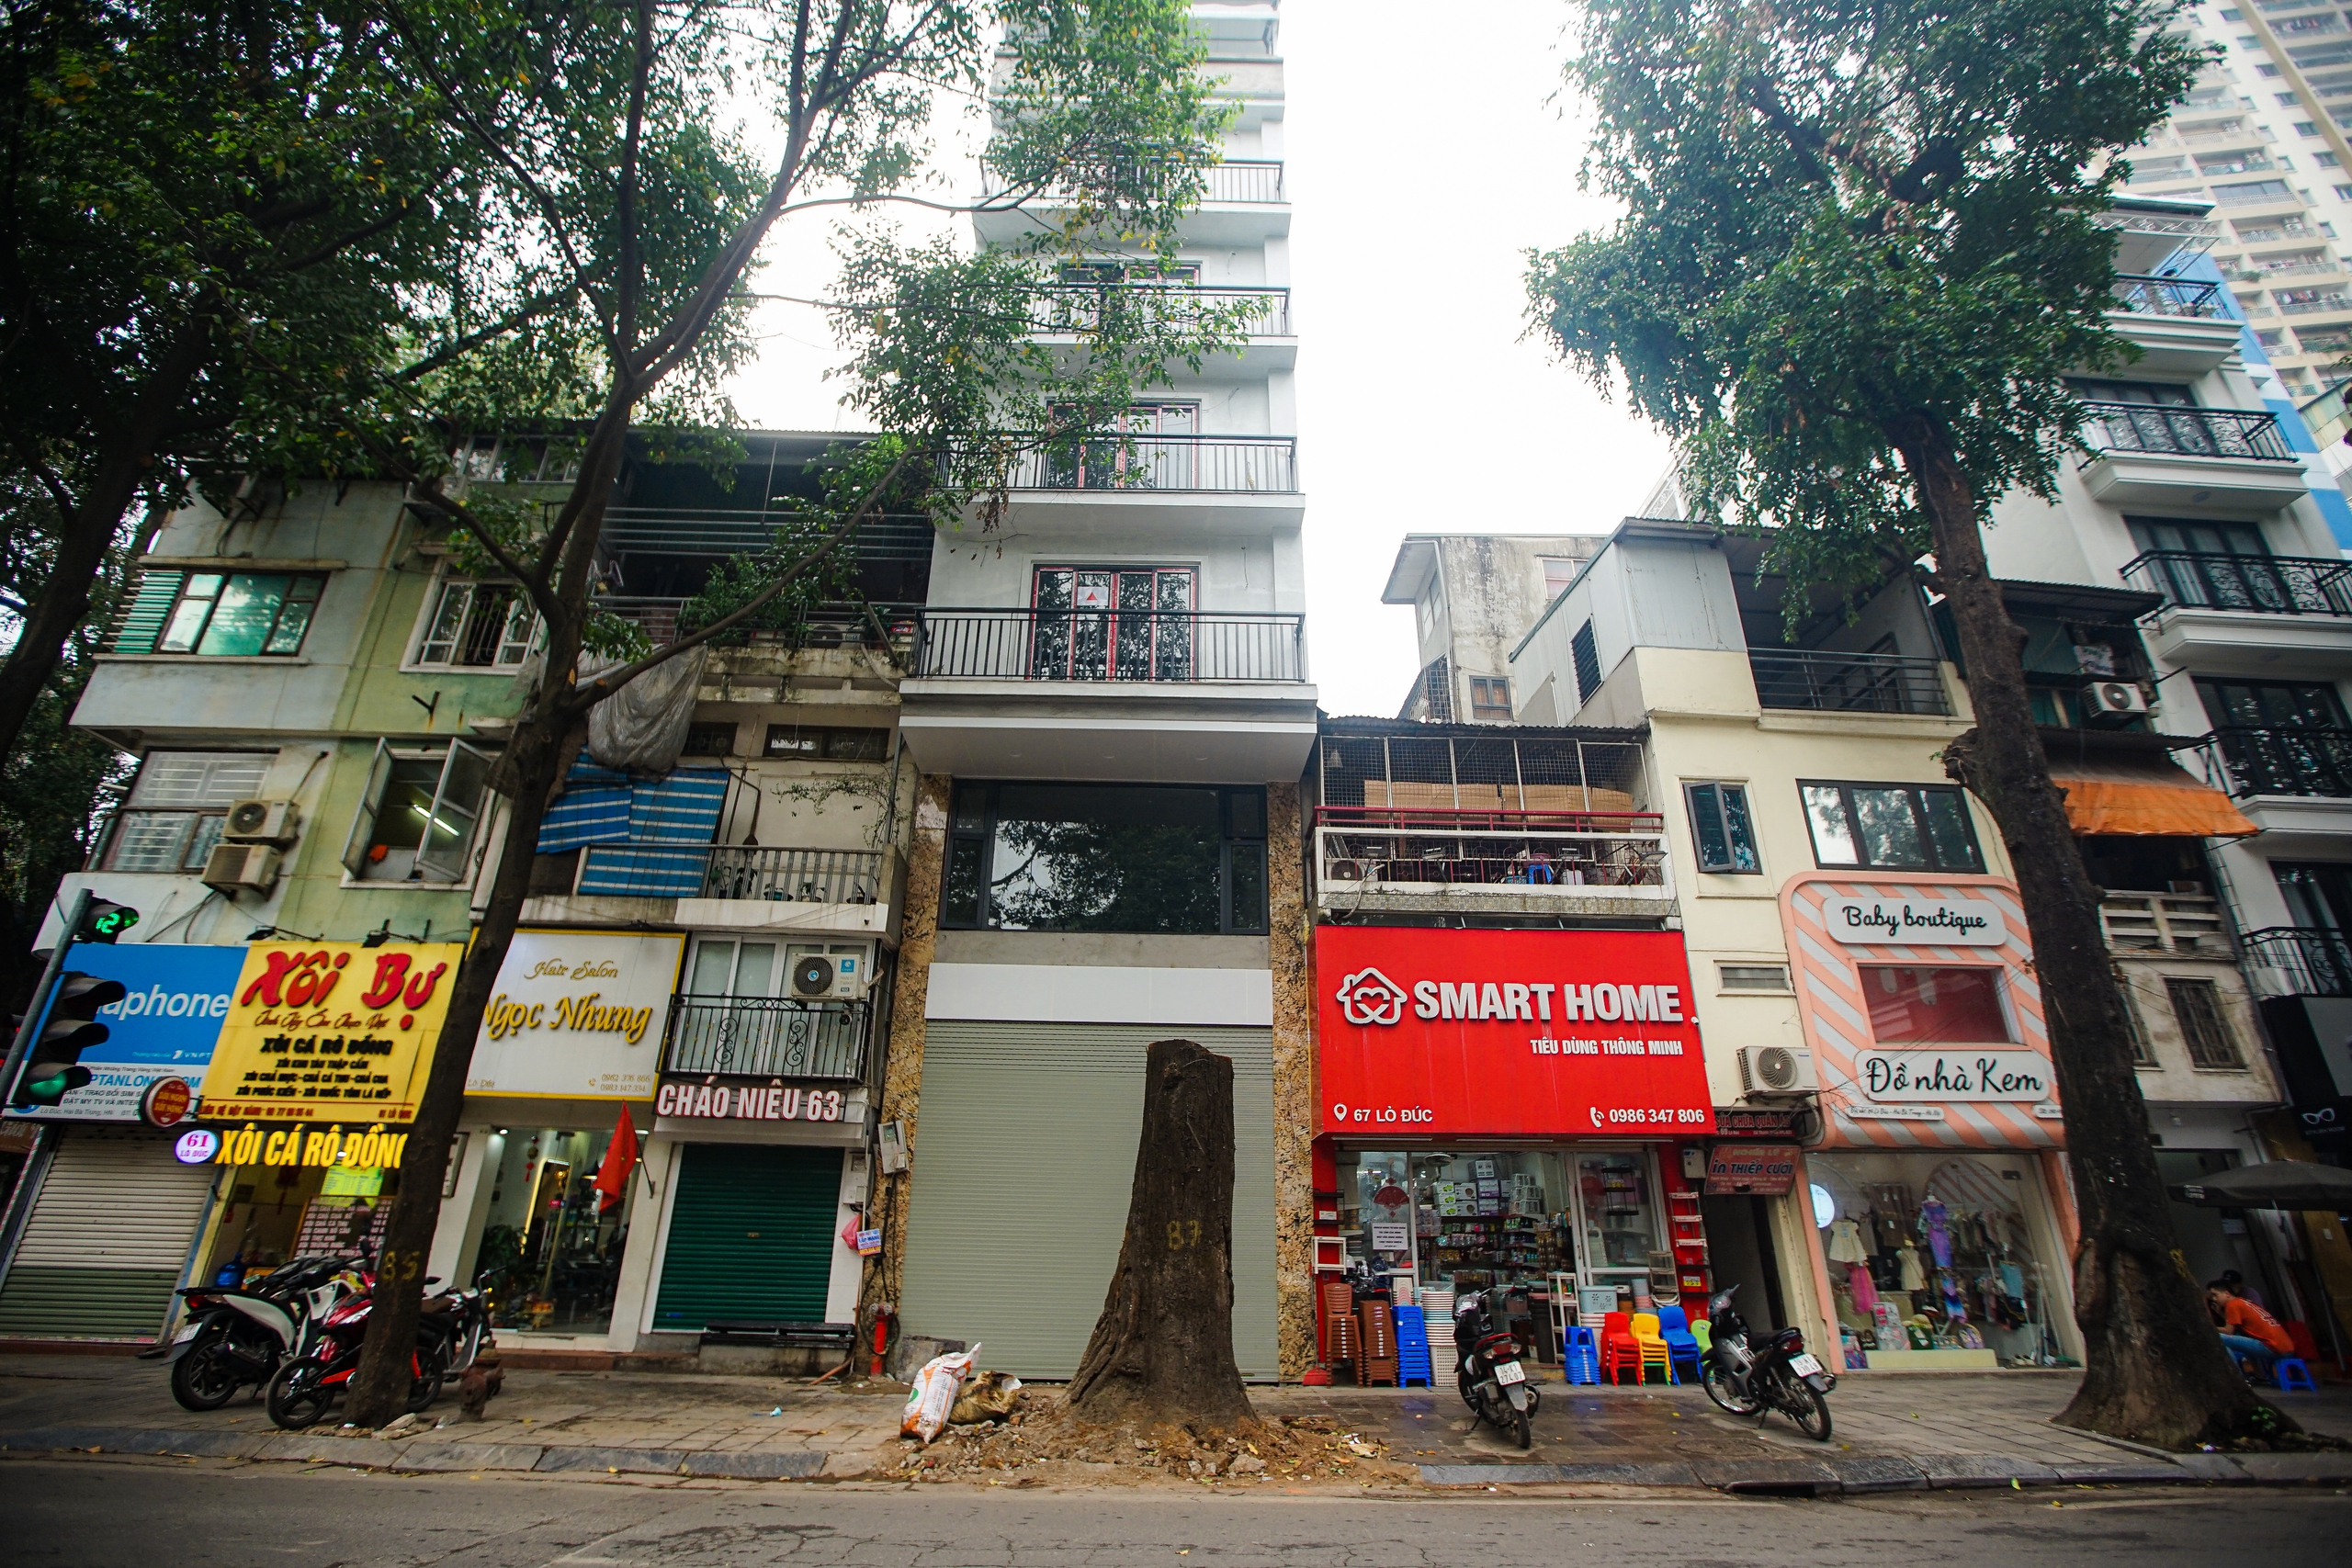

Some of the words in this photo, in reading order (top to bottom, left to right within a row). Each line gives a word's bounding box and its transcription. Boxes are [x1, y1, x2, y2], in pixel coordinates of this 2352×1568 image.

[1842, 904, 1900, 937] Baby
[1904, 905, 1987, 936] boutique
[524, 958, 569, 979] Hair
[571, 960, 618, 980] Salon
[97, 984, 231, 1021] aphone
[241, 950, 350, 1008] Xôi
[361, 953, 447, 1030] Bự
[1414, 980, 1555, 1021] SMART
[1564, 983, 1683, 1021] HOME
[483, 993, 544, 1040] Ngọc
[548, 992, 653, 1045] Nhung
[1530, 1036, 1559, 1055] TIÊU
[1562, 1036, 1599, 1055] DÙNG
[1601, 1036, 1645, 1055] THÔNG
[1648, 1040, 1683, 1055] MINH
[1865, 1057, 1909, 1093] Đồ
[1915, 1058, 1973, 1091] nhà
[1976, 1058, 2042, 1093] Kem
[656, 1075, 731, 1117] CHÁO
[736, 1078, 801, 1120] NIÊU
[807, 1089, 841, 1122] 63
[1353, 1109, 1371, 1122] 67
[1375, 1105, 1396, 1122] LÒ
[1400, 1105, 1433, 1122] ĐÚC
[1609, 1109, 1645, 1123] 0986
[1647, 1109, 1674, 1123] 347
[1678, 1109, 1705, 1123] 806
[187, 1133, 210, 1147] 61
[215, 1122, 266, 1166] XÔI
[264, 1123, 304, 1167] CÁ
[302, 1124, 343, 1168] RÔ
